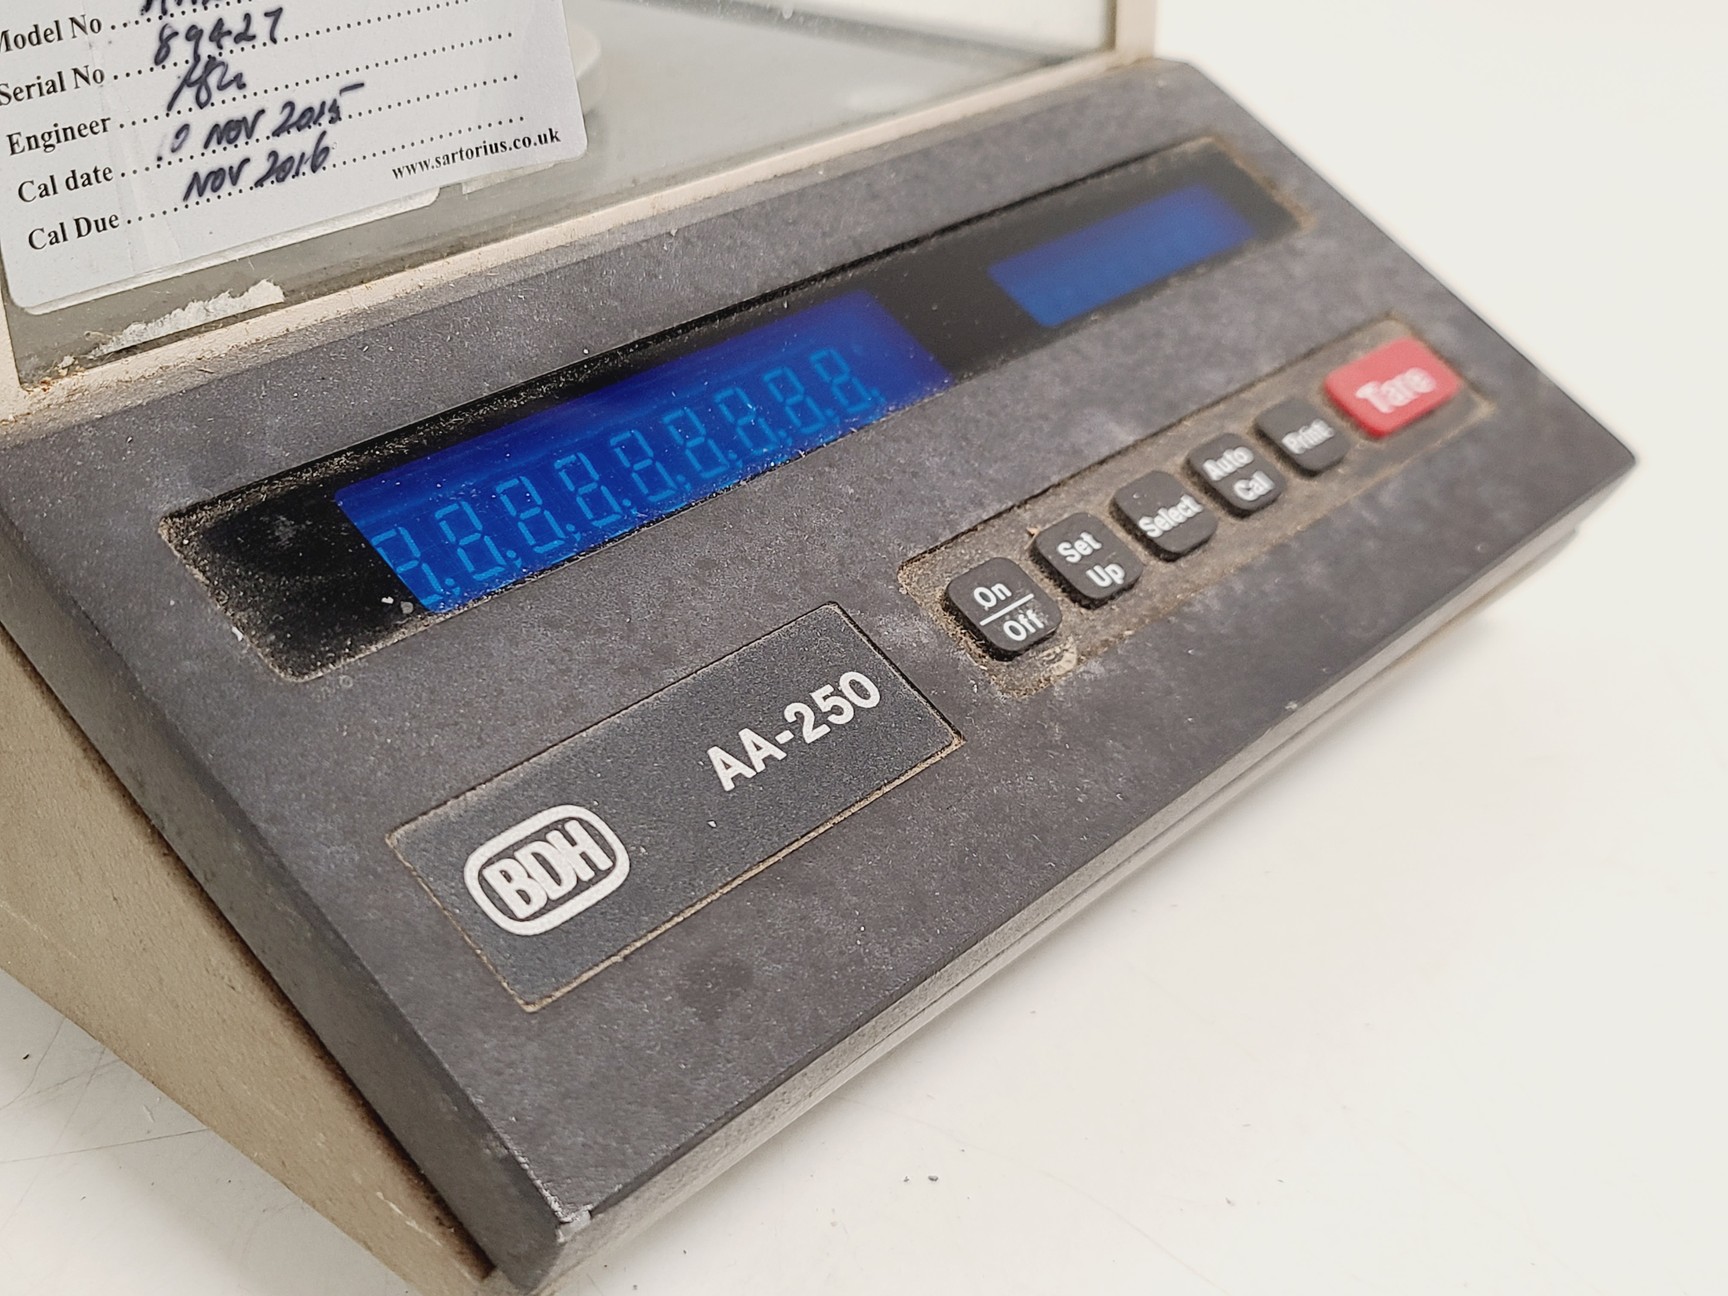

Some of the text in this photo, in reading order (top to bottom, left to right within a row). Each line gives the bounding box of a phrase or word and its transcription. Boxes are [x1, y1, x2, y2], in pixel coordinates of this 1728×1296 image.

[69, 14, 102, 38] No
[154, 7, 283, 66] 89427
[0, 65, 105, 106] Serial No
[6, 117, 111, 156] Engineer
[392, 127, 562, 180] www.sartorius.co.uk
[18, 165, 113, 202] Cal date
[28, 214, 119, 250] Cal Due
[1356, 366, 1437, 414] Tare
[1281, 418, 1335, 455] Print
[1202, 446, 1255, 482] Auto
[1233, 470, 1275, 502] Cal
[1138, 495, 1203, 539] Select
[1057, 531, 1102, 565] Set
[1086, 561, 1126, 590] Up
[973, 581, 1012, 608] On
[1002, 609, 1045, 643] Off
[706, 671, 881, 792] AA-250
[482, 819, 613, 920] BDH
